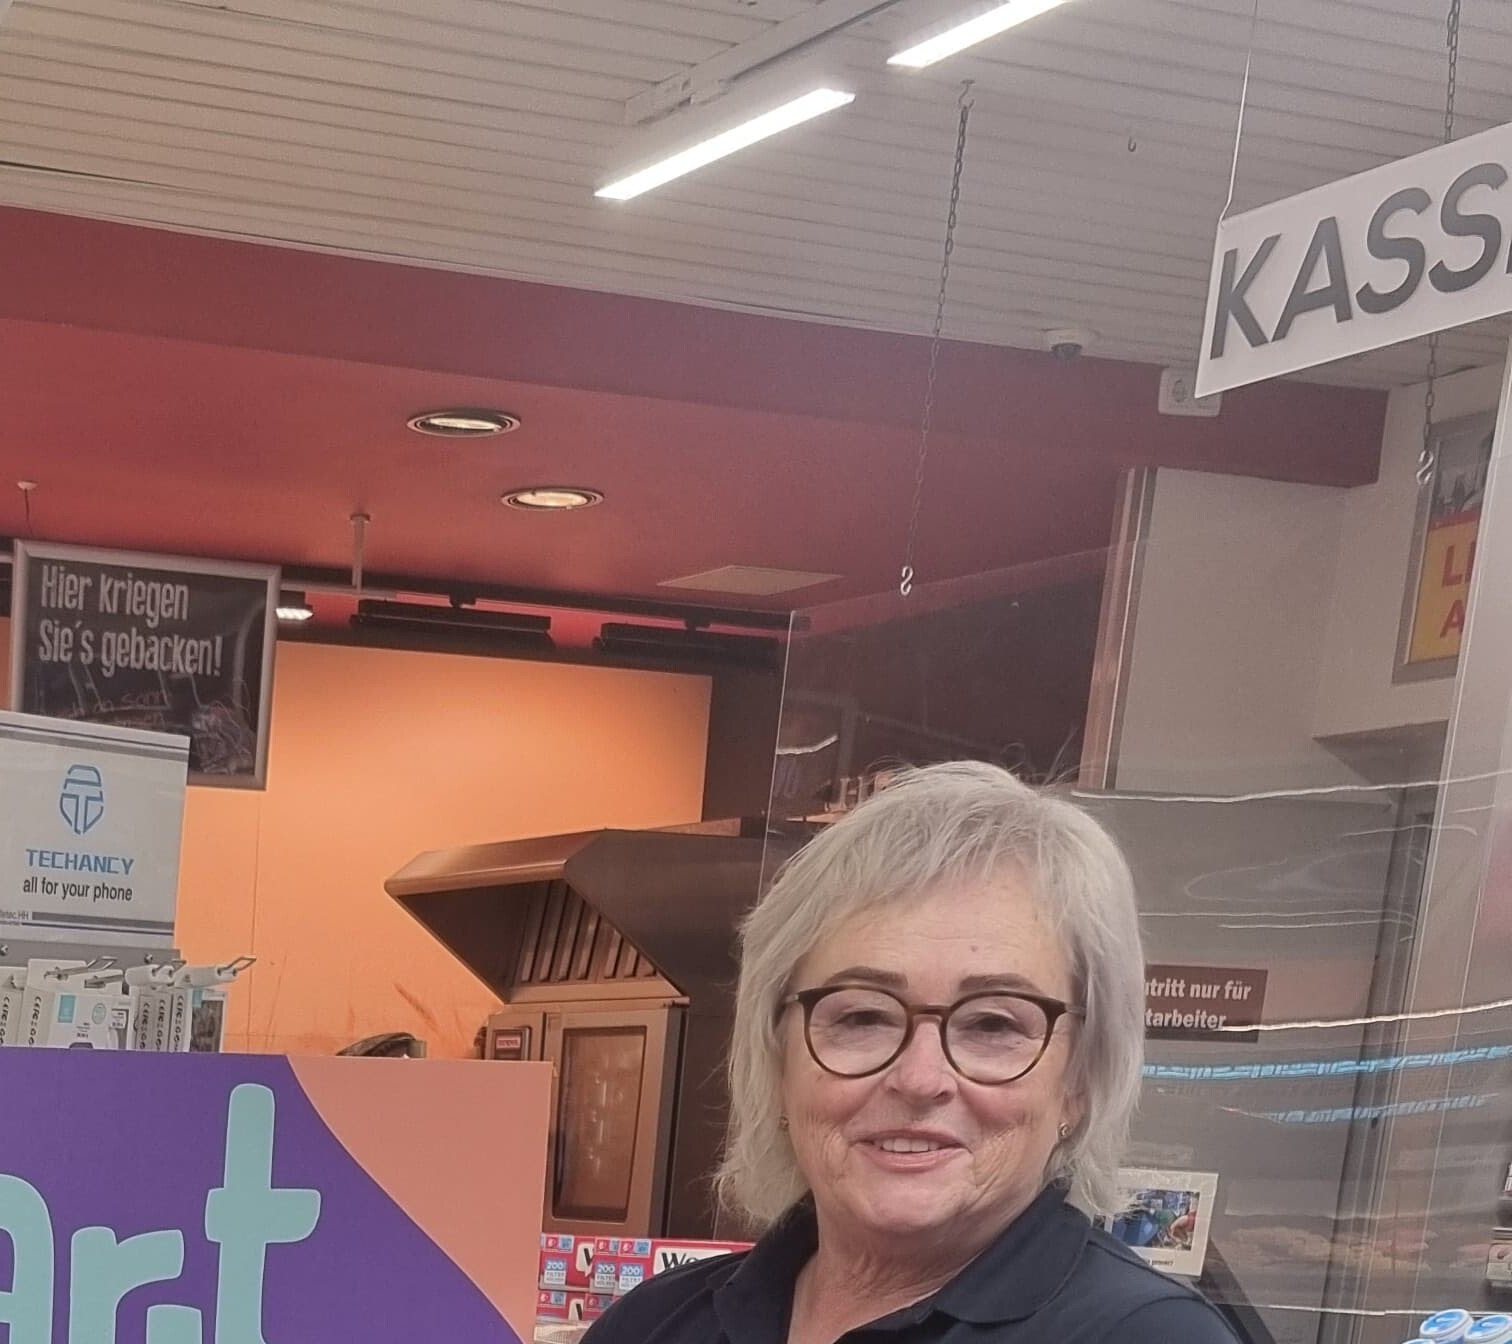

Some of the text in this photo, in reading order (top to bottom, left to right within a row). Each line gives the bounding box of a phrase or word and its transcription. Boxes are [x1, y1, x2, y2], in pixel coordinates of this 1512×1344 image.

[1210, 162, 1512, 360] KASS
[41, 565, 188, 628] Hier kriegen
[101, 627, 223, 677] gebacken!
[25, 848, 136, 876] TECHANCY
[1145, 978, 1252, 1000] tritt nur für
[1145, 1008, 1227, 1030] tarbeiter
[546, 1261, 565, 1271] 200
